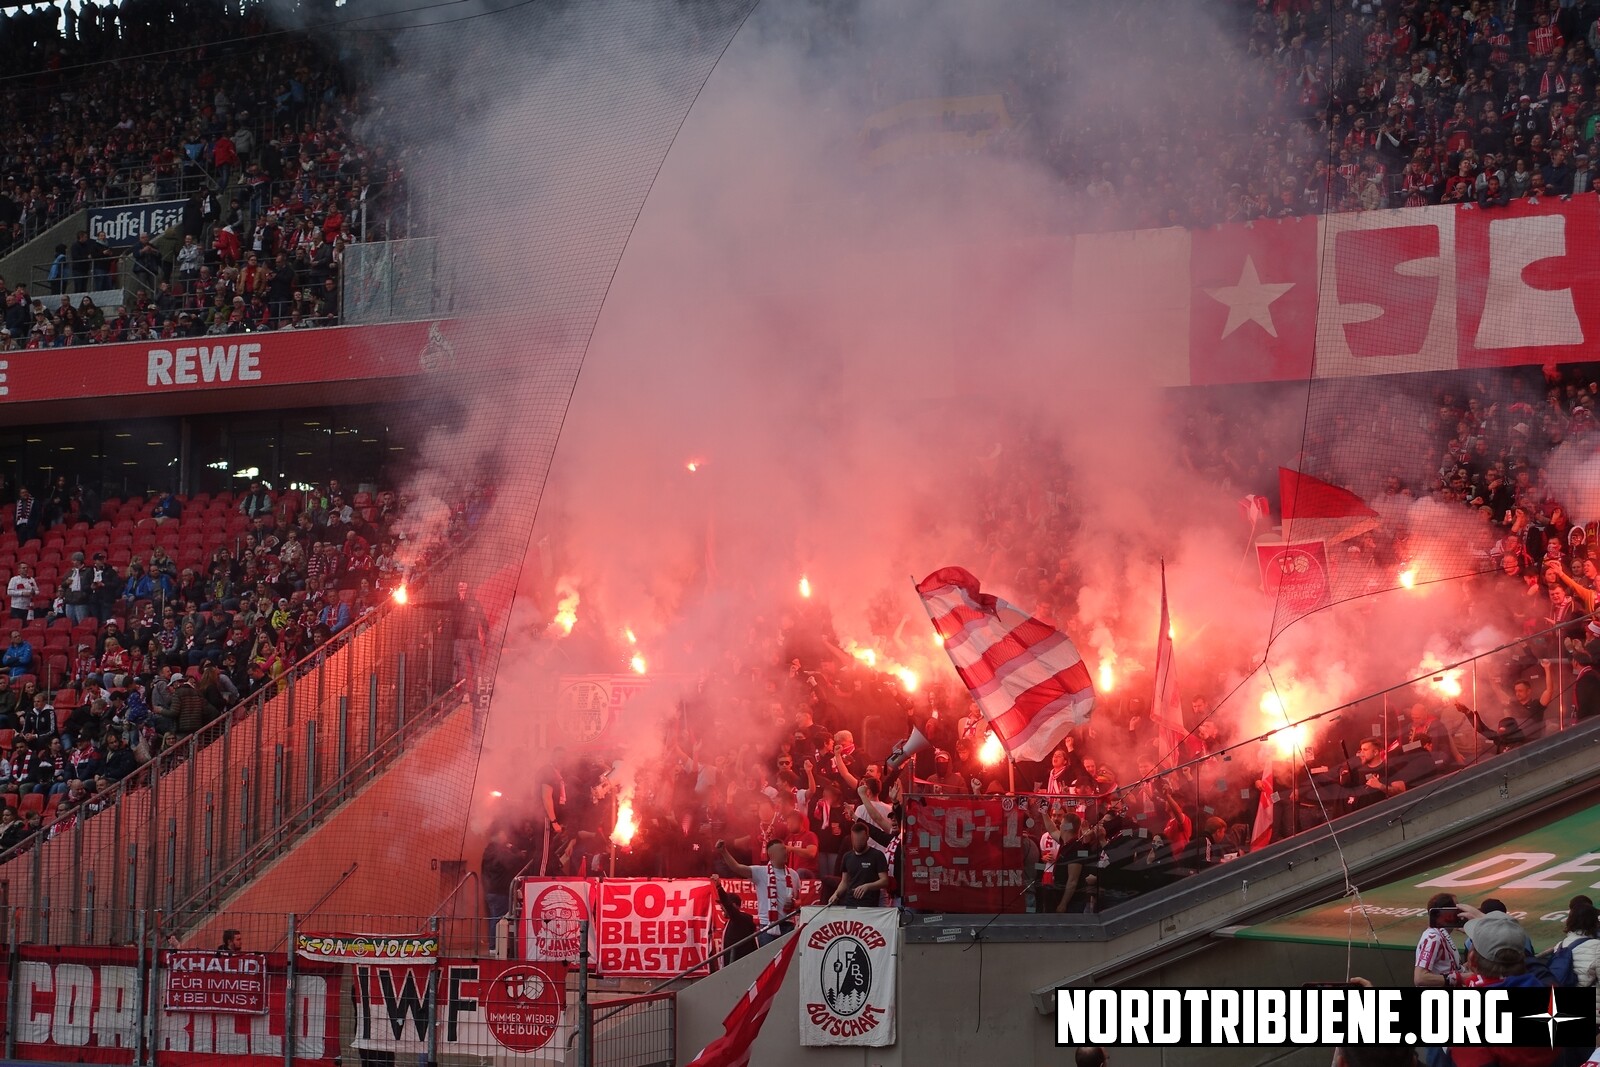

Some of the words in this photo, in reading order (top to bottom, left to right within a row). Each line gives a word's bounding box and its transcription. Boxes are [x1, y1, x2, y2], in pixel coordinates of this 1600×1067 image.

[90, 210, 145, 240] Gaffel
[147, 343, 262, 386] REWE
[1414, 852, 1600, 889] DE
[602, 884, 712, 919] 50+1
[536, 936, 546, 948] 10
[601, 920, 708, 945] BLEIBT.
[808, 920, 887, 950] FREIBURGER
[373, 939, 434, 958] VOLTS
[172, 957, 260, 975] KHALID
[171, 975, 203, 989] FÜR
[207, 979, 261, 992] IMMER
[183, 992, 207, 1003] BEI
[212, 993, 247, 1005] UNS
[356, 964, 480, 1042] IWF
[496, 1023, 548, 1036] FREIBURG
[525, 1014, 555, 1024] WIEDER
[806, 1003, 886, 1037] BOTSCHAFT
